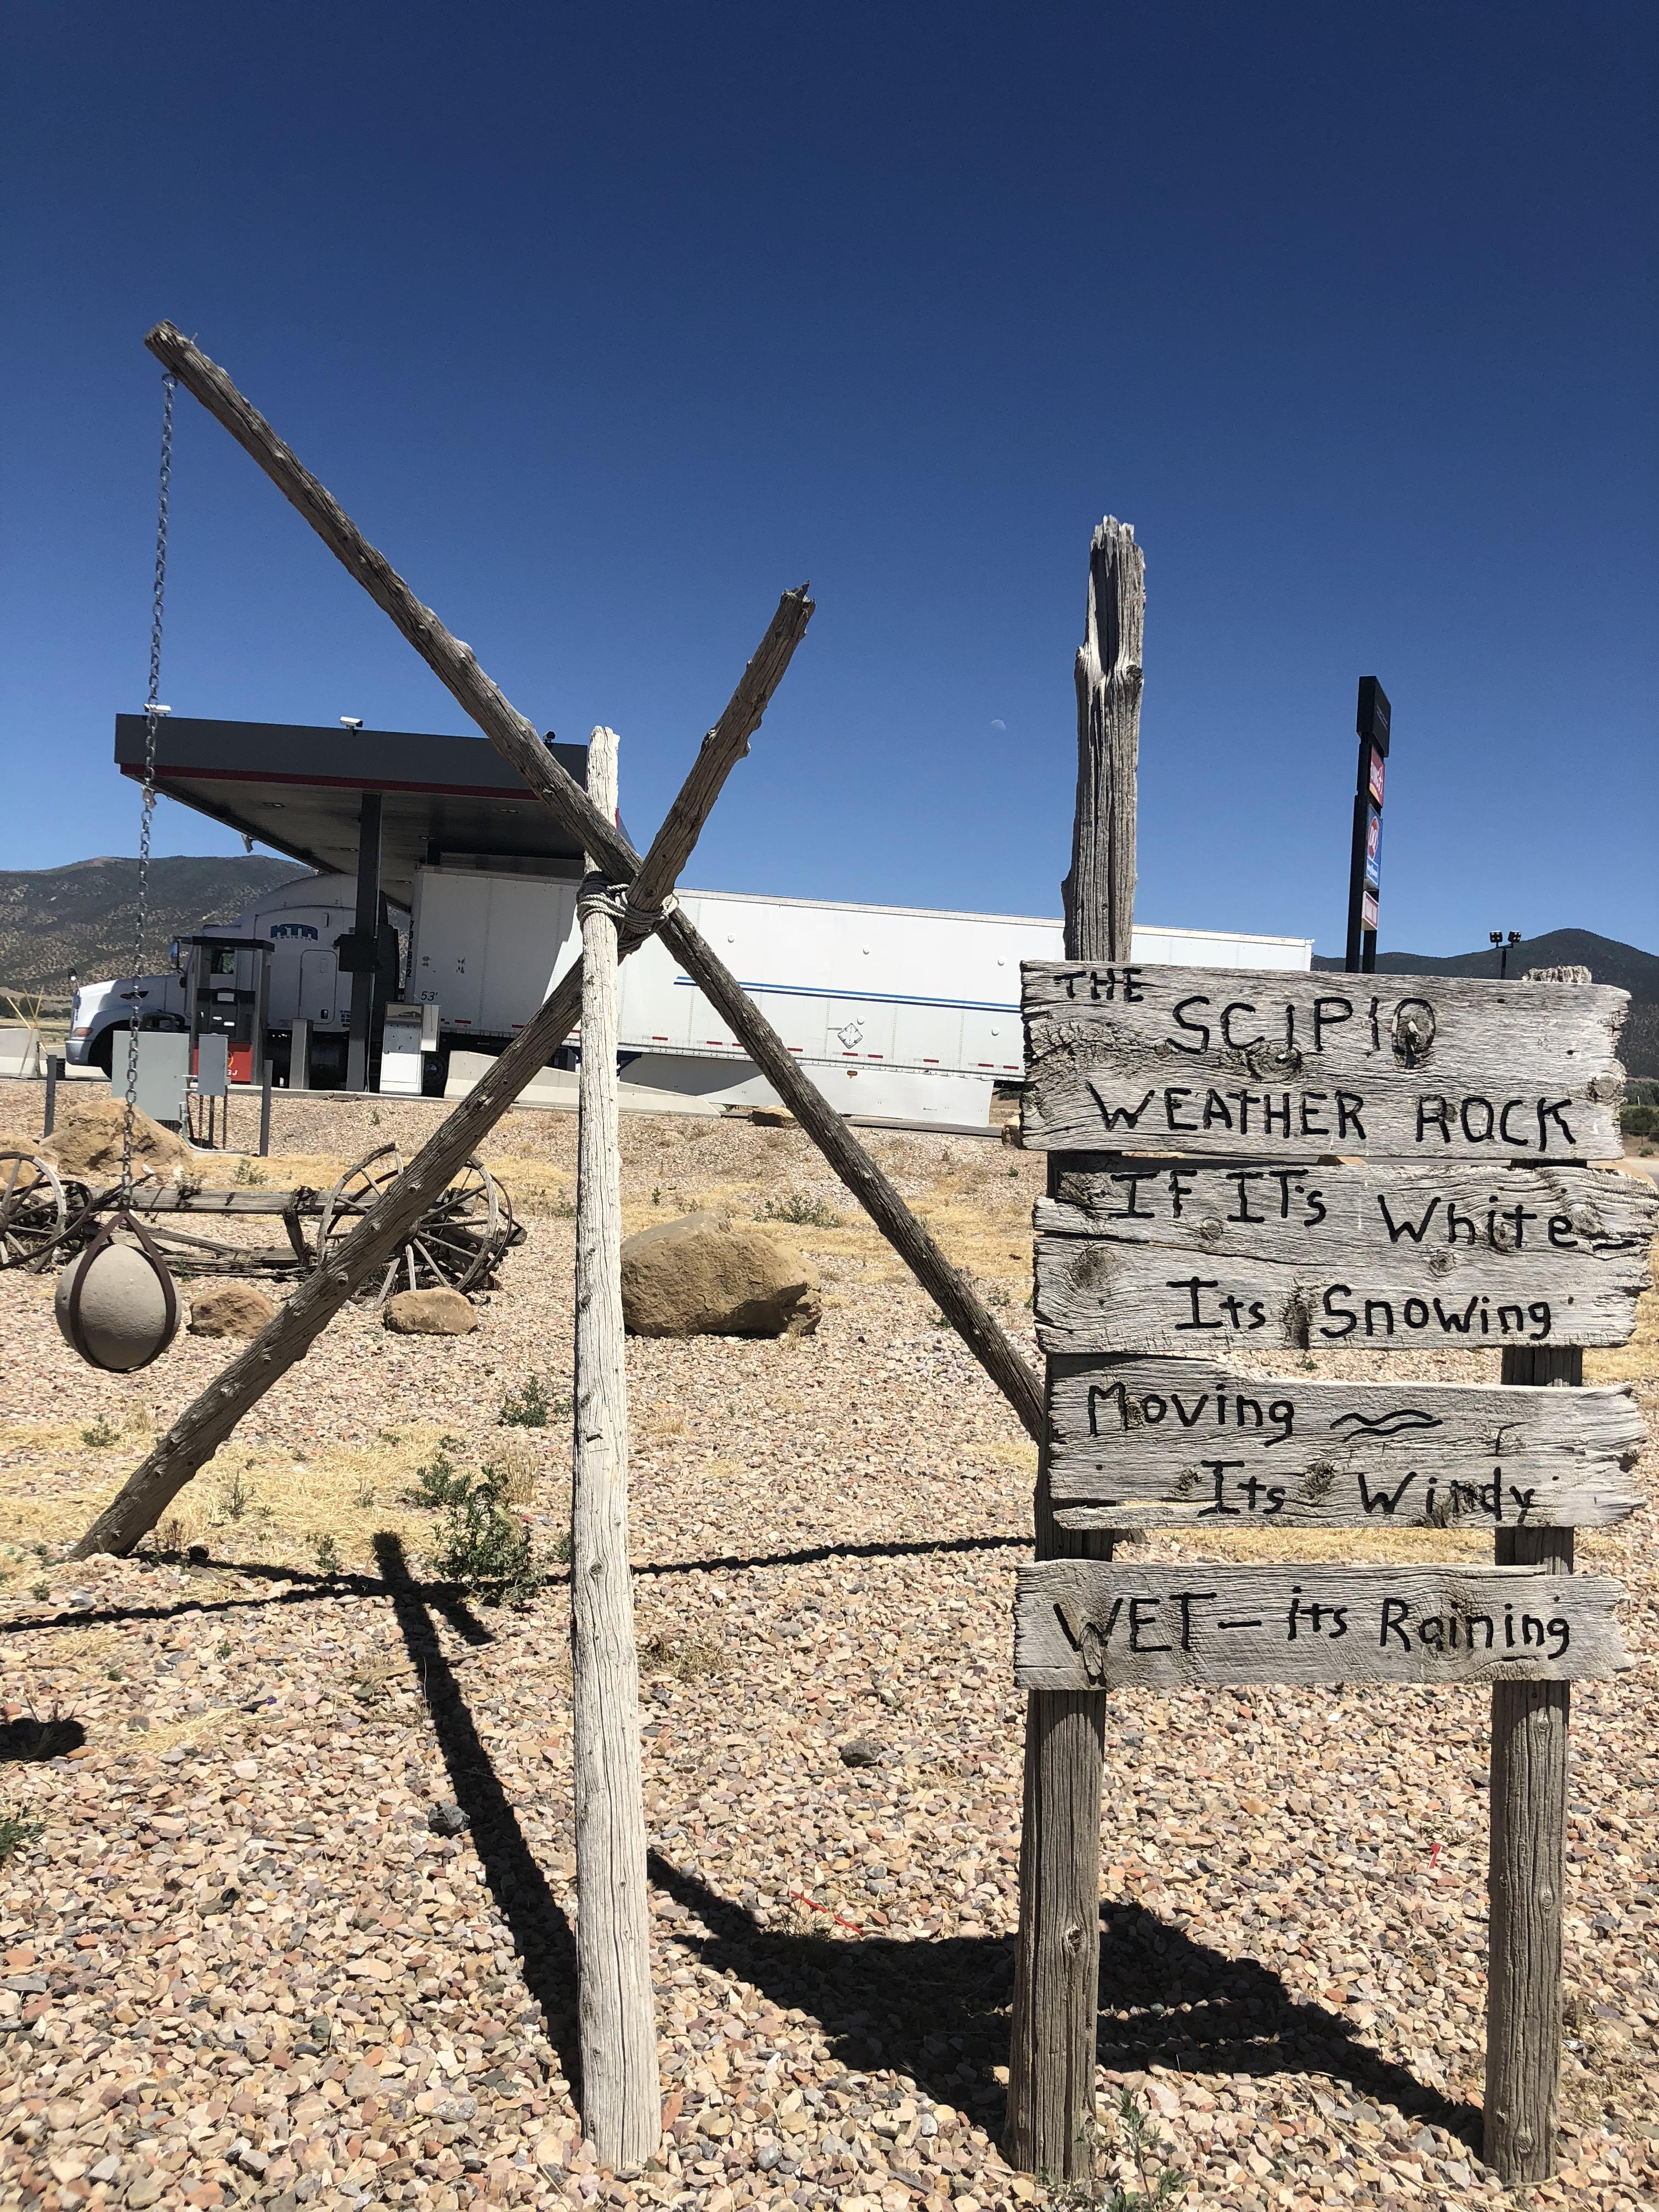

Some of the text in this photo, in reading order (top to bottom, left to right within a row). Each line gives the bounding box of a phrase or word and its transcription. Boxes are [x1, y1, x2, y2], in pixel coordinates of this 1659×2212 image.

[421, 991, 438, 1001] 53'
[1054, 967, 1143, 1002] THE
[1166, 995, 1436, 1054] SCIPIO
[1085, 1081, 1577, 1152] WEATHER ROCK
[1109, 1170, 1198, 1218] IF
[1378, 1194, 1578, 1249] White
[1166, 1276, 1551, 1340] Its Snowing
[1087, 1381, 1295, 1447] Moving
[1197, 1460, 1535, 1525] Its Windy
[1053, 1592, 1217, 1653] WET
[1380, 1598, 1570, 1660] Raining
